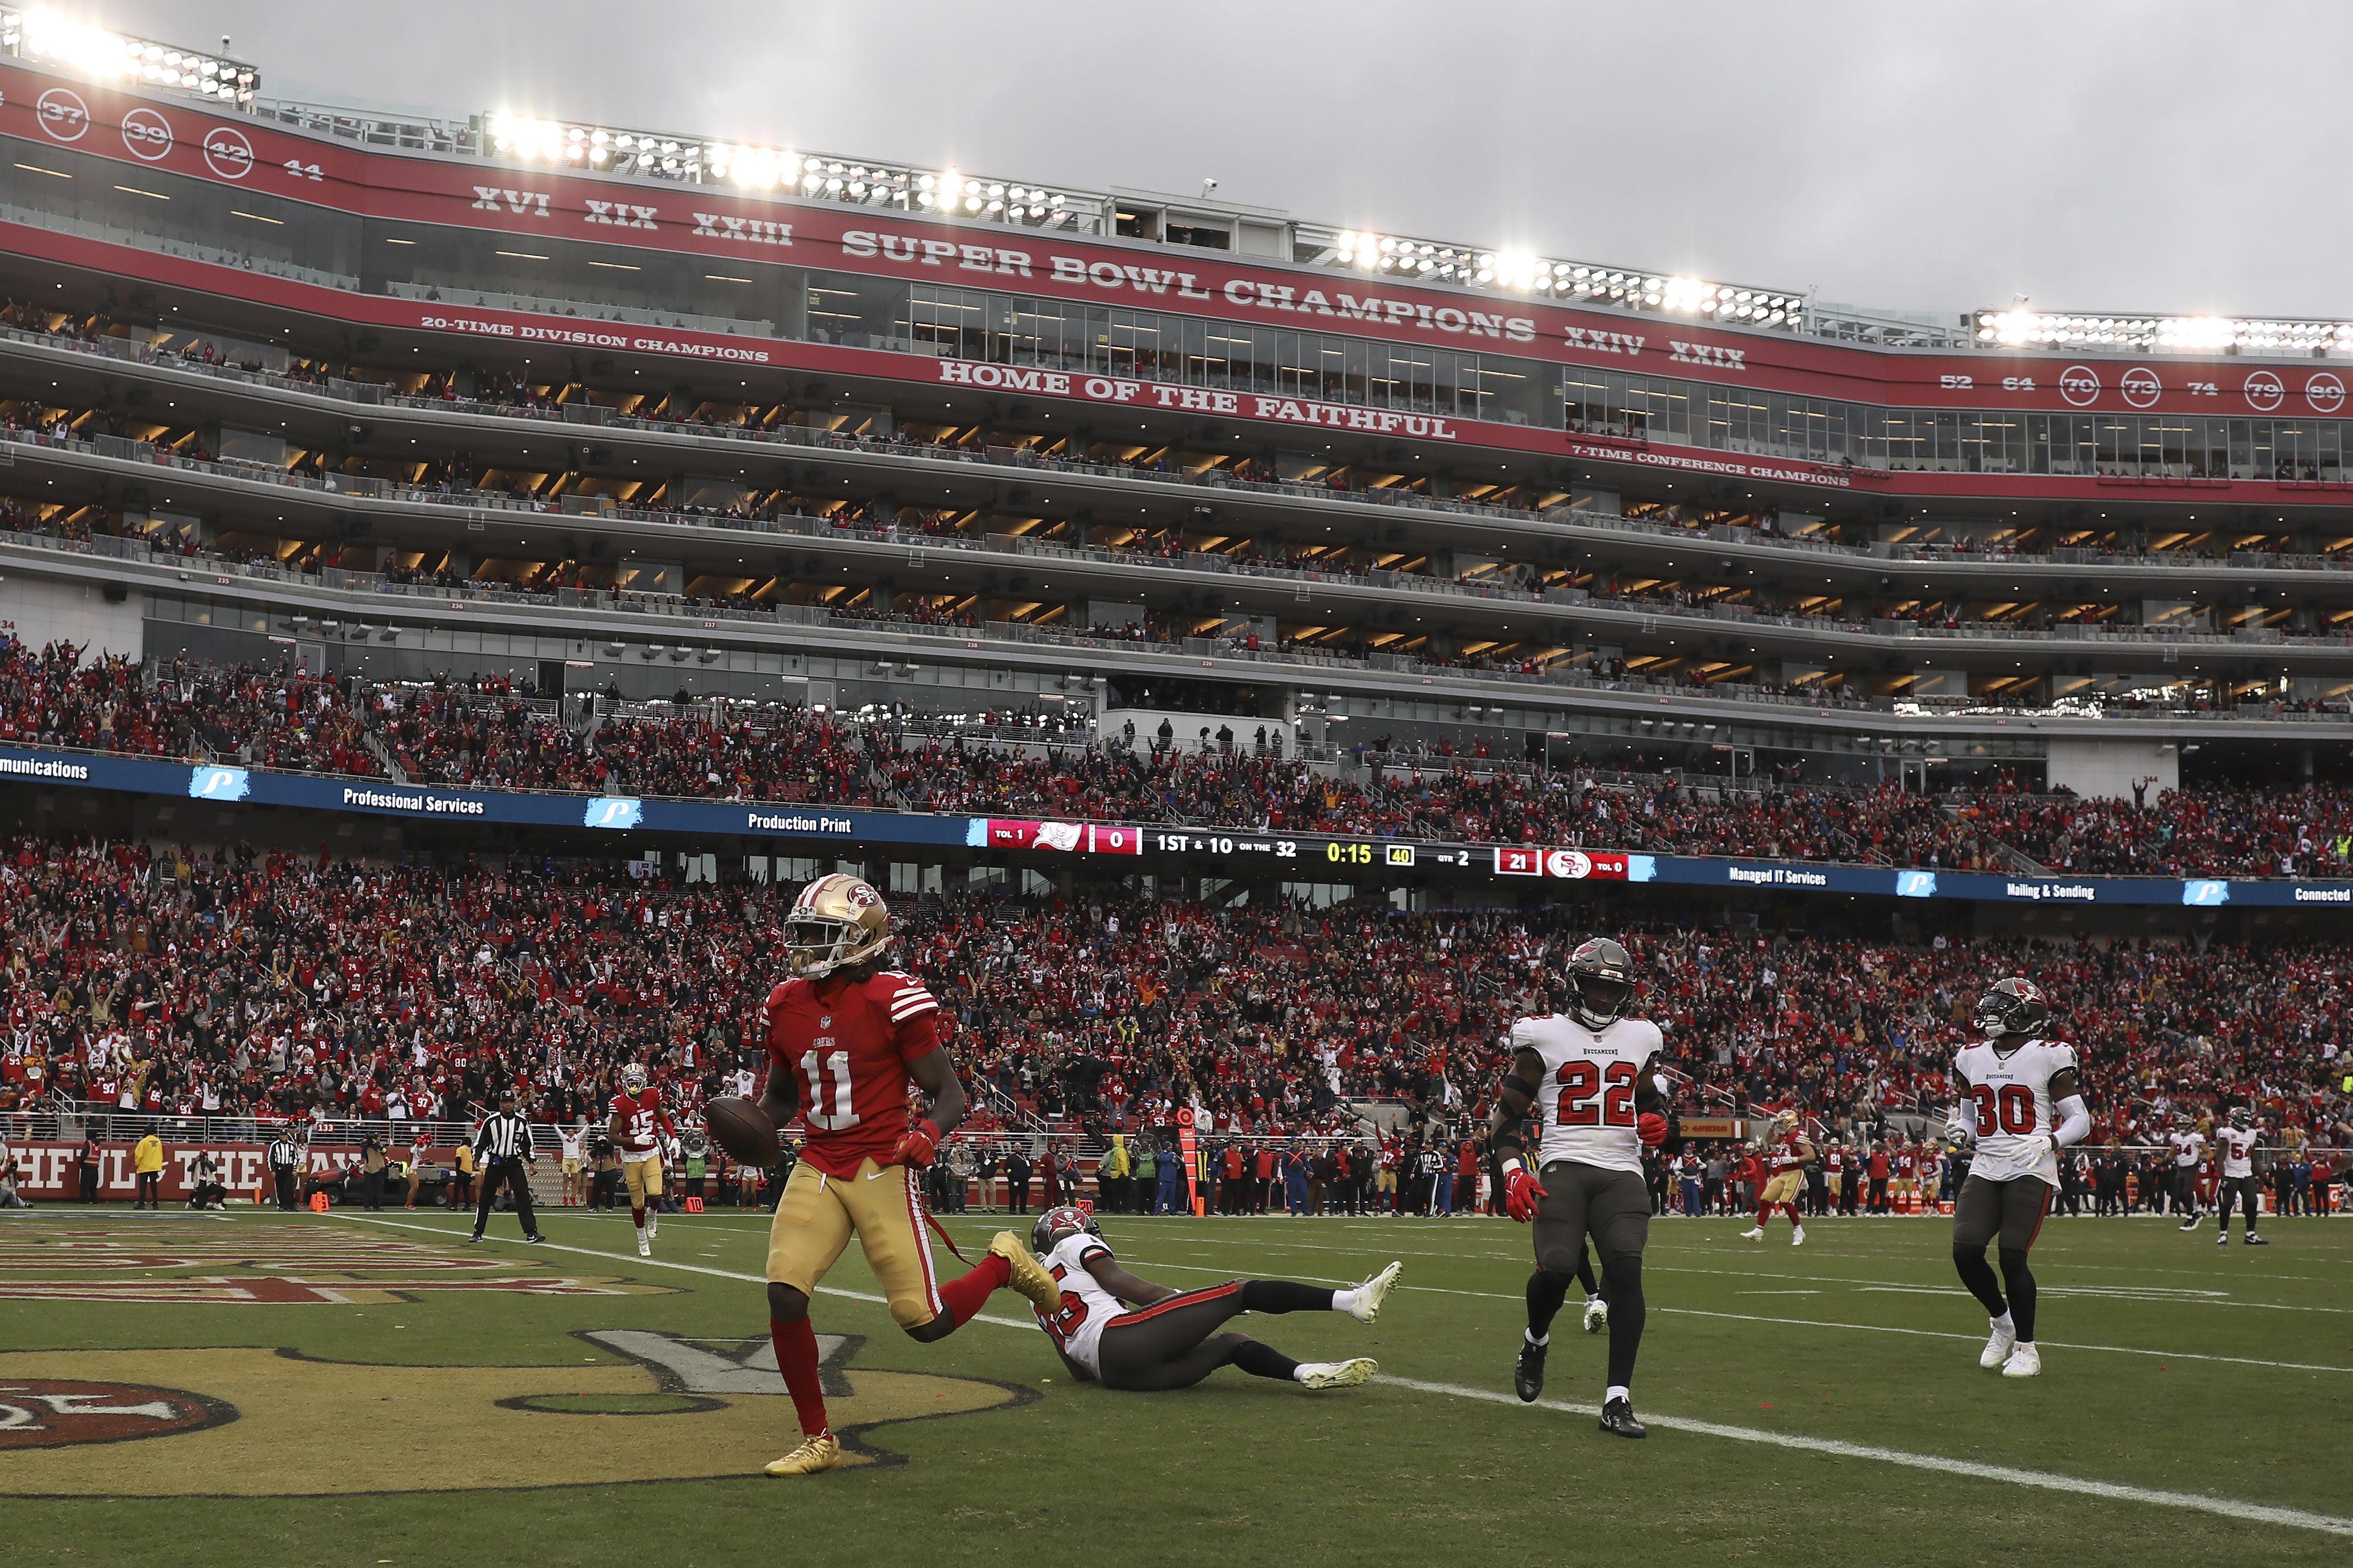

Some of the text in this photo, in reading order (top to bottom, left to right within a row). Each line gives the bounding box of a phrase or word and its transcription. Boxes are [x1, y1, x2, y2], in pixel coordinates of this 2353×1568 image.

[41, 101, 83, 124] 37
[126, 122, 168, 144] 39
[209, 142, 248, 163] 42
[283, 159, 323, 182] 44
[472, 186, 793, 246] XVI XIX XXIII
[842, 229, 1537, 342] SUPER BOWL CHAMPIONS
[421, 316, 769, 362] 20-TIME DIVISION CHAMPIONS
[1564, 326, 1746, 371] XXIV XXIX
[1940, 374, 1973, 390] 52
[2002, 376, 2036, 392] 64
[2063, 378, 2096, 394] 70
[2125, 379, 2158, 396] 73
[2187, 381, 2219, 397] 74
[2248, 383, 2279, 399] 79
[2309, 386, 2341, 400] 80
[939, 360, 1456, 440] HOME OF THE FAITHFUL
[1571, 445, 1850, 488] 7-TIME CONFERENCE CHAMPIONS
[0, 620, 14, 629] 34
[343, 788, 484, 815] Professional Services
[748, 813, 851, 833] Production Print
[995, 829, 1024, 840] TOL 1
[1110, 832, 1123, 848] 0
[1158, 835, 1296, 857] 1ST & 10 ON THE 32
[1328, 843, 1371, 864] 0:15
[1392, 849, 1410, 863] 40
[1438, 851, 1469, 867] QTR 2
[1510, 854, 1527, 869] 21
[1597, 861, 1622, 873] TOL 0
[1730, 867, 1826, 885] Managed IT Services
[855, 886, 875, 904] SF
[2008, 883, 2095, 901] Mailing & Sending
[2295, 888, 2350, 901] Connected
[351, 984, 361, 992] 97
[145, 1029, 155, 1039] 16
[813, 1036, 835, 1048] 49ERS
[319, 1041, 324, 1050] 8
[455, 1058, 467, 1067] 80
[102, 1086, 115, 1094] 97
[801, 1050, 859, 1131] 11
[1113, 1086, 1122, 1095] 44
[1556, 1060, 1638, 1127] 22
[180, 1104, 192, 1114] 97
[417, 1098, 428, 1107] 97
[683, 1100, 692, 1108] 97
[1973, 1084, 2036, 1136] 30
[630, 1110, 654, 1135] 15
[1154, 1117, 1165, 1126] 53
[2231, 1143, 2251, 1160] 54
[1830, 1154, 1841, 1166] 81
[1898, 1156, 1912, 1168] 44
[2330, 1189, 2338, 1202] G
[1080, 1201, 1093, 1213] 20
